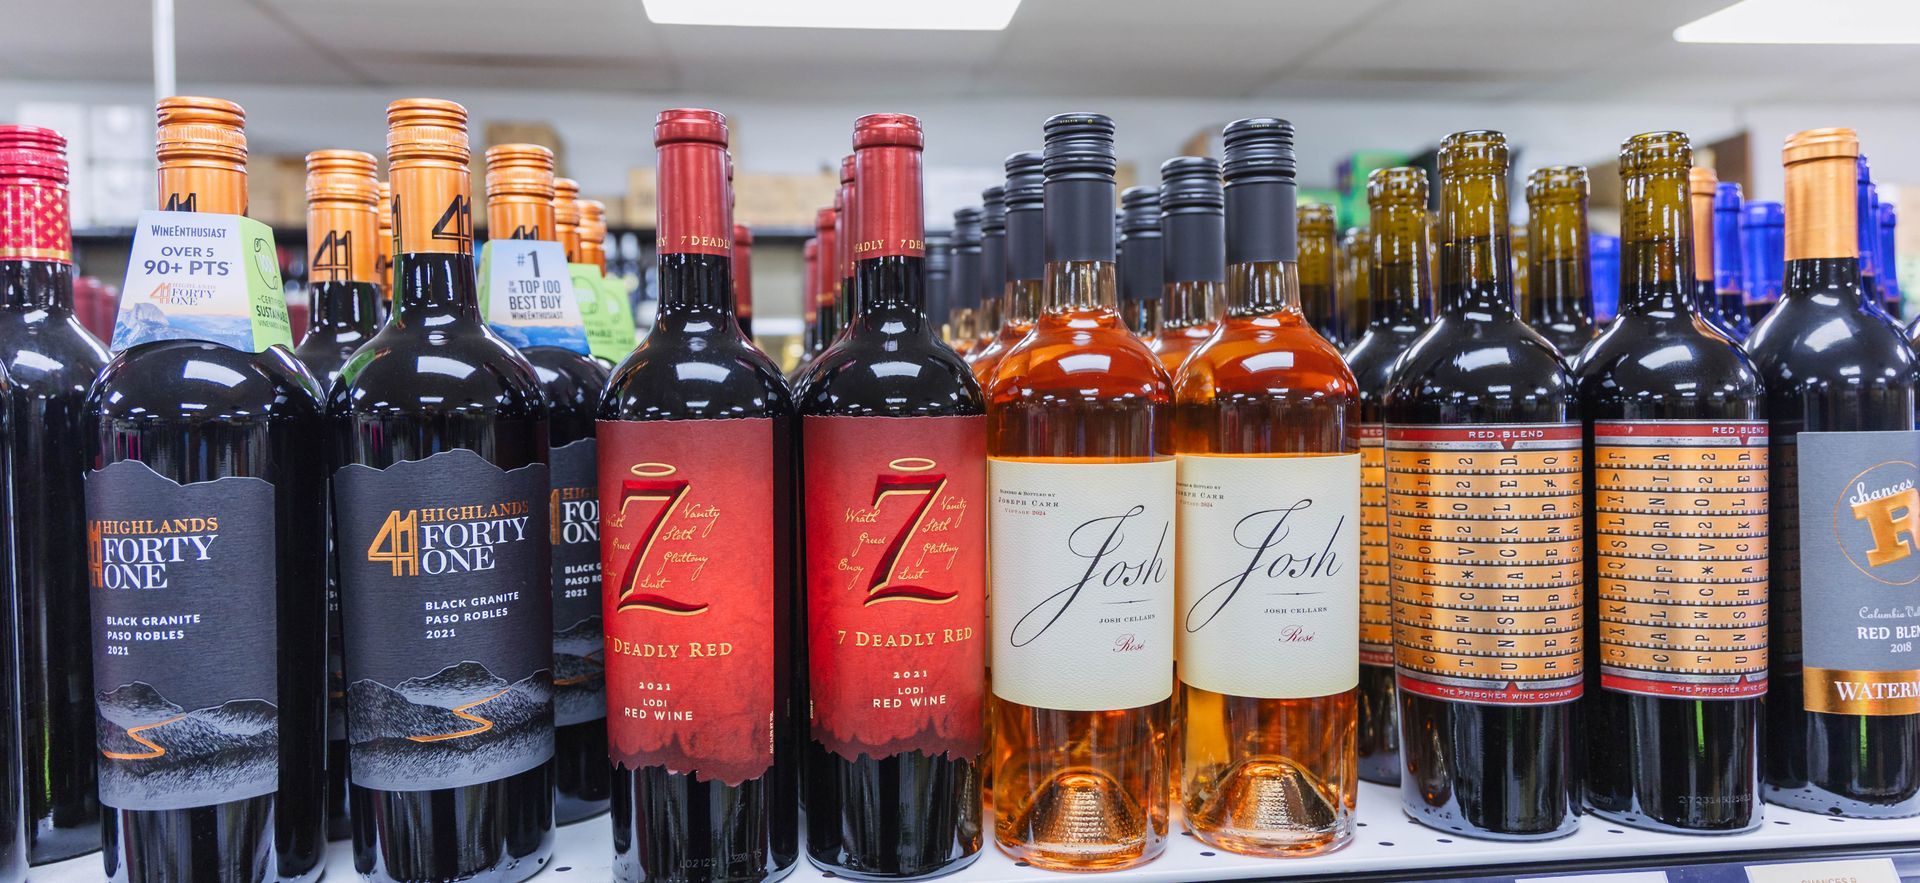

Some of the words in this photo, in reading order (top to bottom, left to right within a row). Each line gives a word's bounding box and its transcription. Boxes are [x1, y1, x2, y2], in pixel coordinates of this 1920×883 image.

[681, 236, 687, 245] 7
[855, 240, 884, 253] EADLY
[900, 239, 906, 249] 7
[161, 246, 202, 257] OVER
[206, 247, 214, 257] 5
[144, 260, 183, 275] 90+
[172, 288, 215, 299] FORTY
[518, 280, 540, 293] TOP
[543, 280, 561, 293] 100
[171, 297, 198, 306] ONE
[509, 296, 537, 310] BEST
[541, 296, 562, 309] BUY
[1468, 431, 1495, 439] RED
[1502, 430, 1544, 439] BLEND
[1712, 426, 1736, 434] RED
[1200, 491, 1224, 500] CARR
[1849, 479, 1915, 504] chances
[998, 496, 1027, 506] JOSEPH
[420, 500, 529, 523] HIGHLANDS
[845, 507, 881, 523] Wrath
[941, 496, 967, 528] Vanity
[102, 517, 219, 535] HIGHLANDS
[683, 502, 721, 538] Vanity
[922, 517, 951, 533] Sloth
[421, 516, 529, 550] FORTY
[563, 521, 600, 544] ON
[662, 526, 697, 541] Sloth
[103, 534, 219, 563] FORTY
[368, 510, 419, 577] 41
[852, 532, 886, 557] Greed
[422, 546, 496, 575] ONE
[916, 542, 959, 570] Gluttony
[1649, 453, 1673, 663] CALIFORNIA
[565, 563, 594, 574] BLACK
[657, 551, 709, 581] Gluttony
[897, 566, 929, 580] Lust
[1185, 499, 1345, 633] Josh
[104, 563, 168, 589] ONE
[565, 576, 590, 586] PASO
[641, 574, 671, 589] Lust
[838, 558, 865, 590] Envy
[1010, 504, 1169, 648] Josh
[565, 588, 588, 598] 2021
[425, 599, 467, 611] BLACK
[471, 591, 519, 606] GRANITE
[425, 613, 459, 625] PASO
[464, 607, 509, 622] ROBLES
[1290, 606, 1328, 614] CELLARS
[1859, 606, 1905, 619] Columbia
[107, 616, 138, 626] BLACK
[142, 614, 201, 625] GRANITE
[1123, 613, 1156, 623] CELLARS
[107, 630, 132, 640] PASO
[135, 630, 184, 641] ROBLES
[426, 628, 456, 639] 2021
[837, 630, 847, 645] 7
[855, 631, 936, 647] DEADLY
[943, 626, 973, 644] RED
[1278, 624, 1316, 643] Rosé
[1857, 626, 1891, 640] RED
[1896, 625, 1920, 639] BLEN
[107, 645, 129, 655] 2021
[614, 638, 680, 658] DEADLY
[688, 642, 733, 658] RED
[1112, 633, 1145, 652] Rosé
[1890, 641, 1912, 653] 2018
[893, 670, 928, 679] 2021
[639, 682, 671, 691] 2021
[897, 686, 924, 695] LODI
[1437, 687, 1455, 695] THE
[1457, 689, 1508, 700] PRISONER
[1512, 692, 1535, 700] WINE
[1538, 690, 1572, 699] COMPANY
[1671, 685, 1692, 693] THE
[1694, 686, 1740, 694] PRISONER
[643, 698, 668, 708] LODI
[873, 698, 902, 709] RED
[909, 694, 946, 707] WINE
[624, 707, 647, 719] RED
[653, 710, 694, 721] WINE
